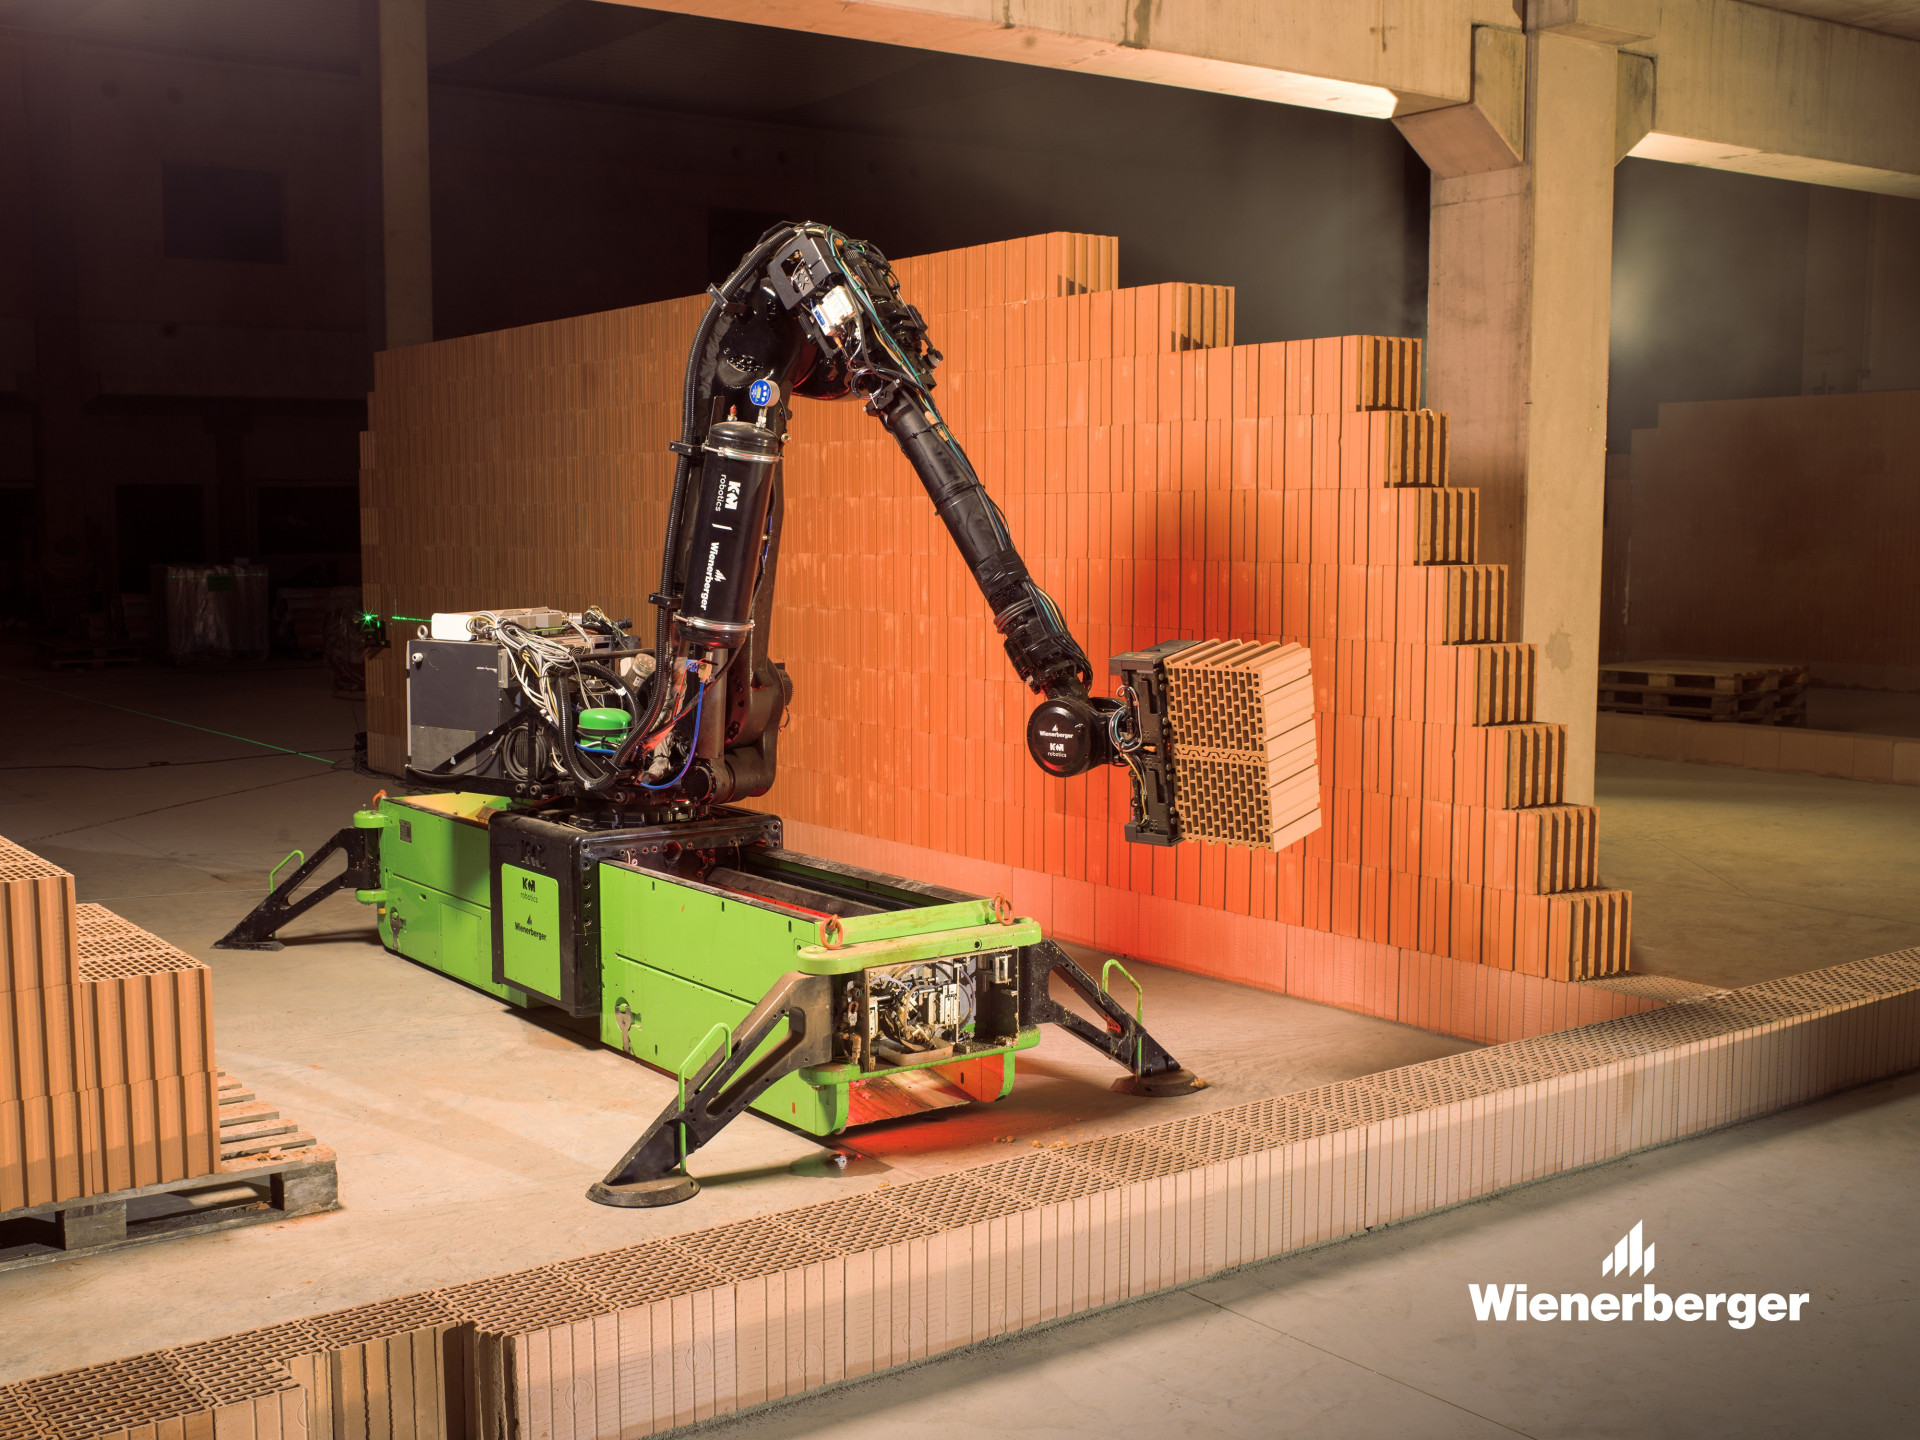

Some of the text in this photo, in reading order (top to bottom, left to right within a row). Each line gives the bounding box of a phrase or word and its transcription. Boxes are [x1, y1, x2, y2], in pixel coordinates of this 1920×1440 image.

[715, 474, 727, 512] robotics
[700, 542, 720, 611] Wienerberger
[1039, 730, 1073, 739] Wienerberger
[515, 921, 547, 940] Wienerberger
